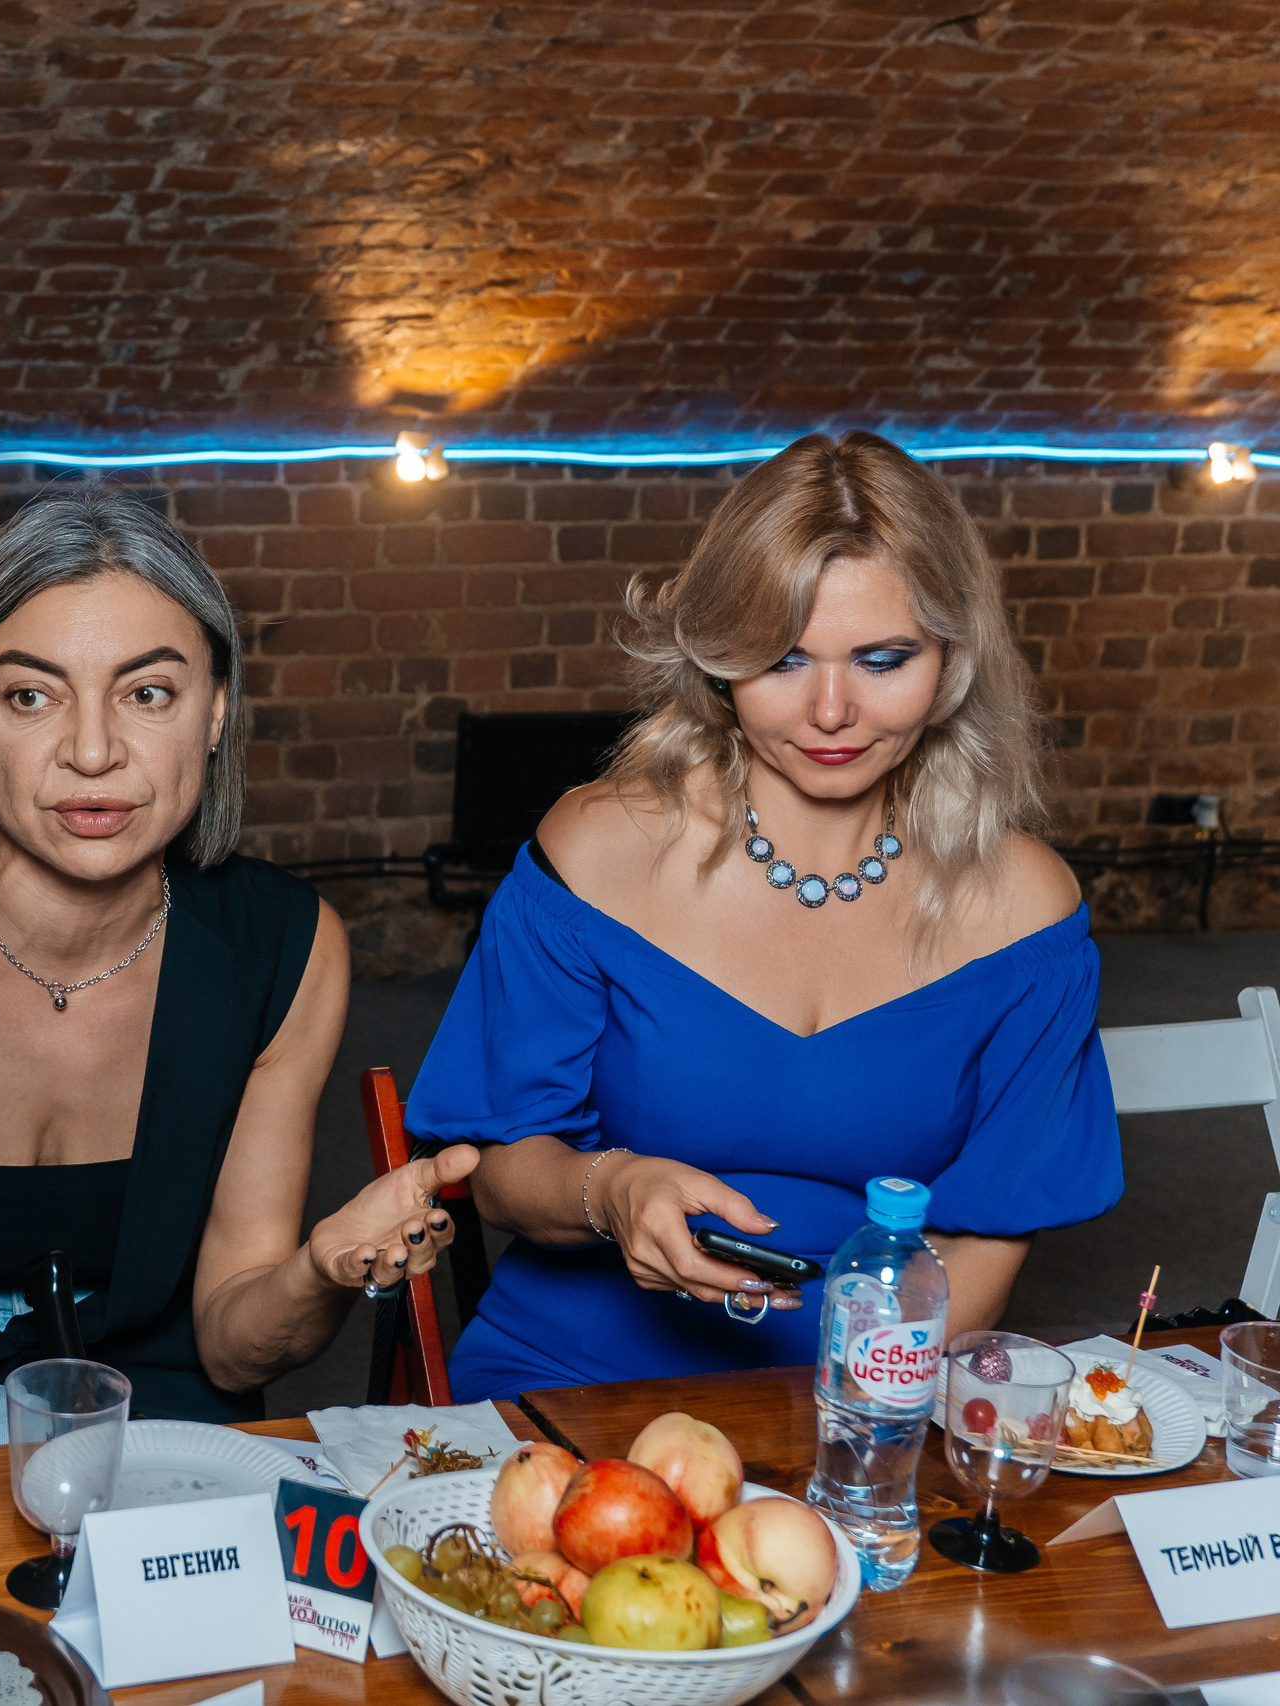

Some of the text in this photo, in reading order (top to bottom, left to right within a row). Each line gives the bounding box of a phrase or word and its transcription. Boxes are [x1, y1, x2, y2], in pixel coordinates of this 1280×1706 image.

[141, 1546, 241, 1581] ЕВГЕНИЯ
[284, 1505, 368, 1588] 10
[1160, 1532, 1264, 1575] ТЕМНЫЙ
